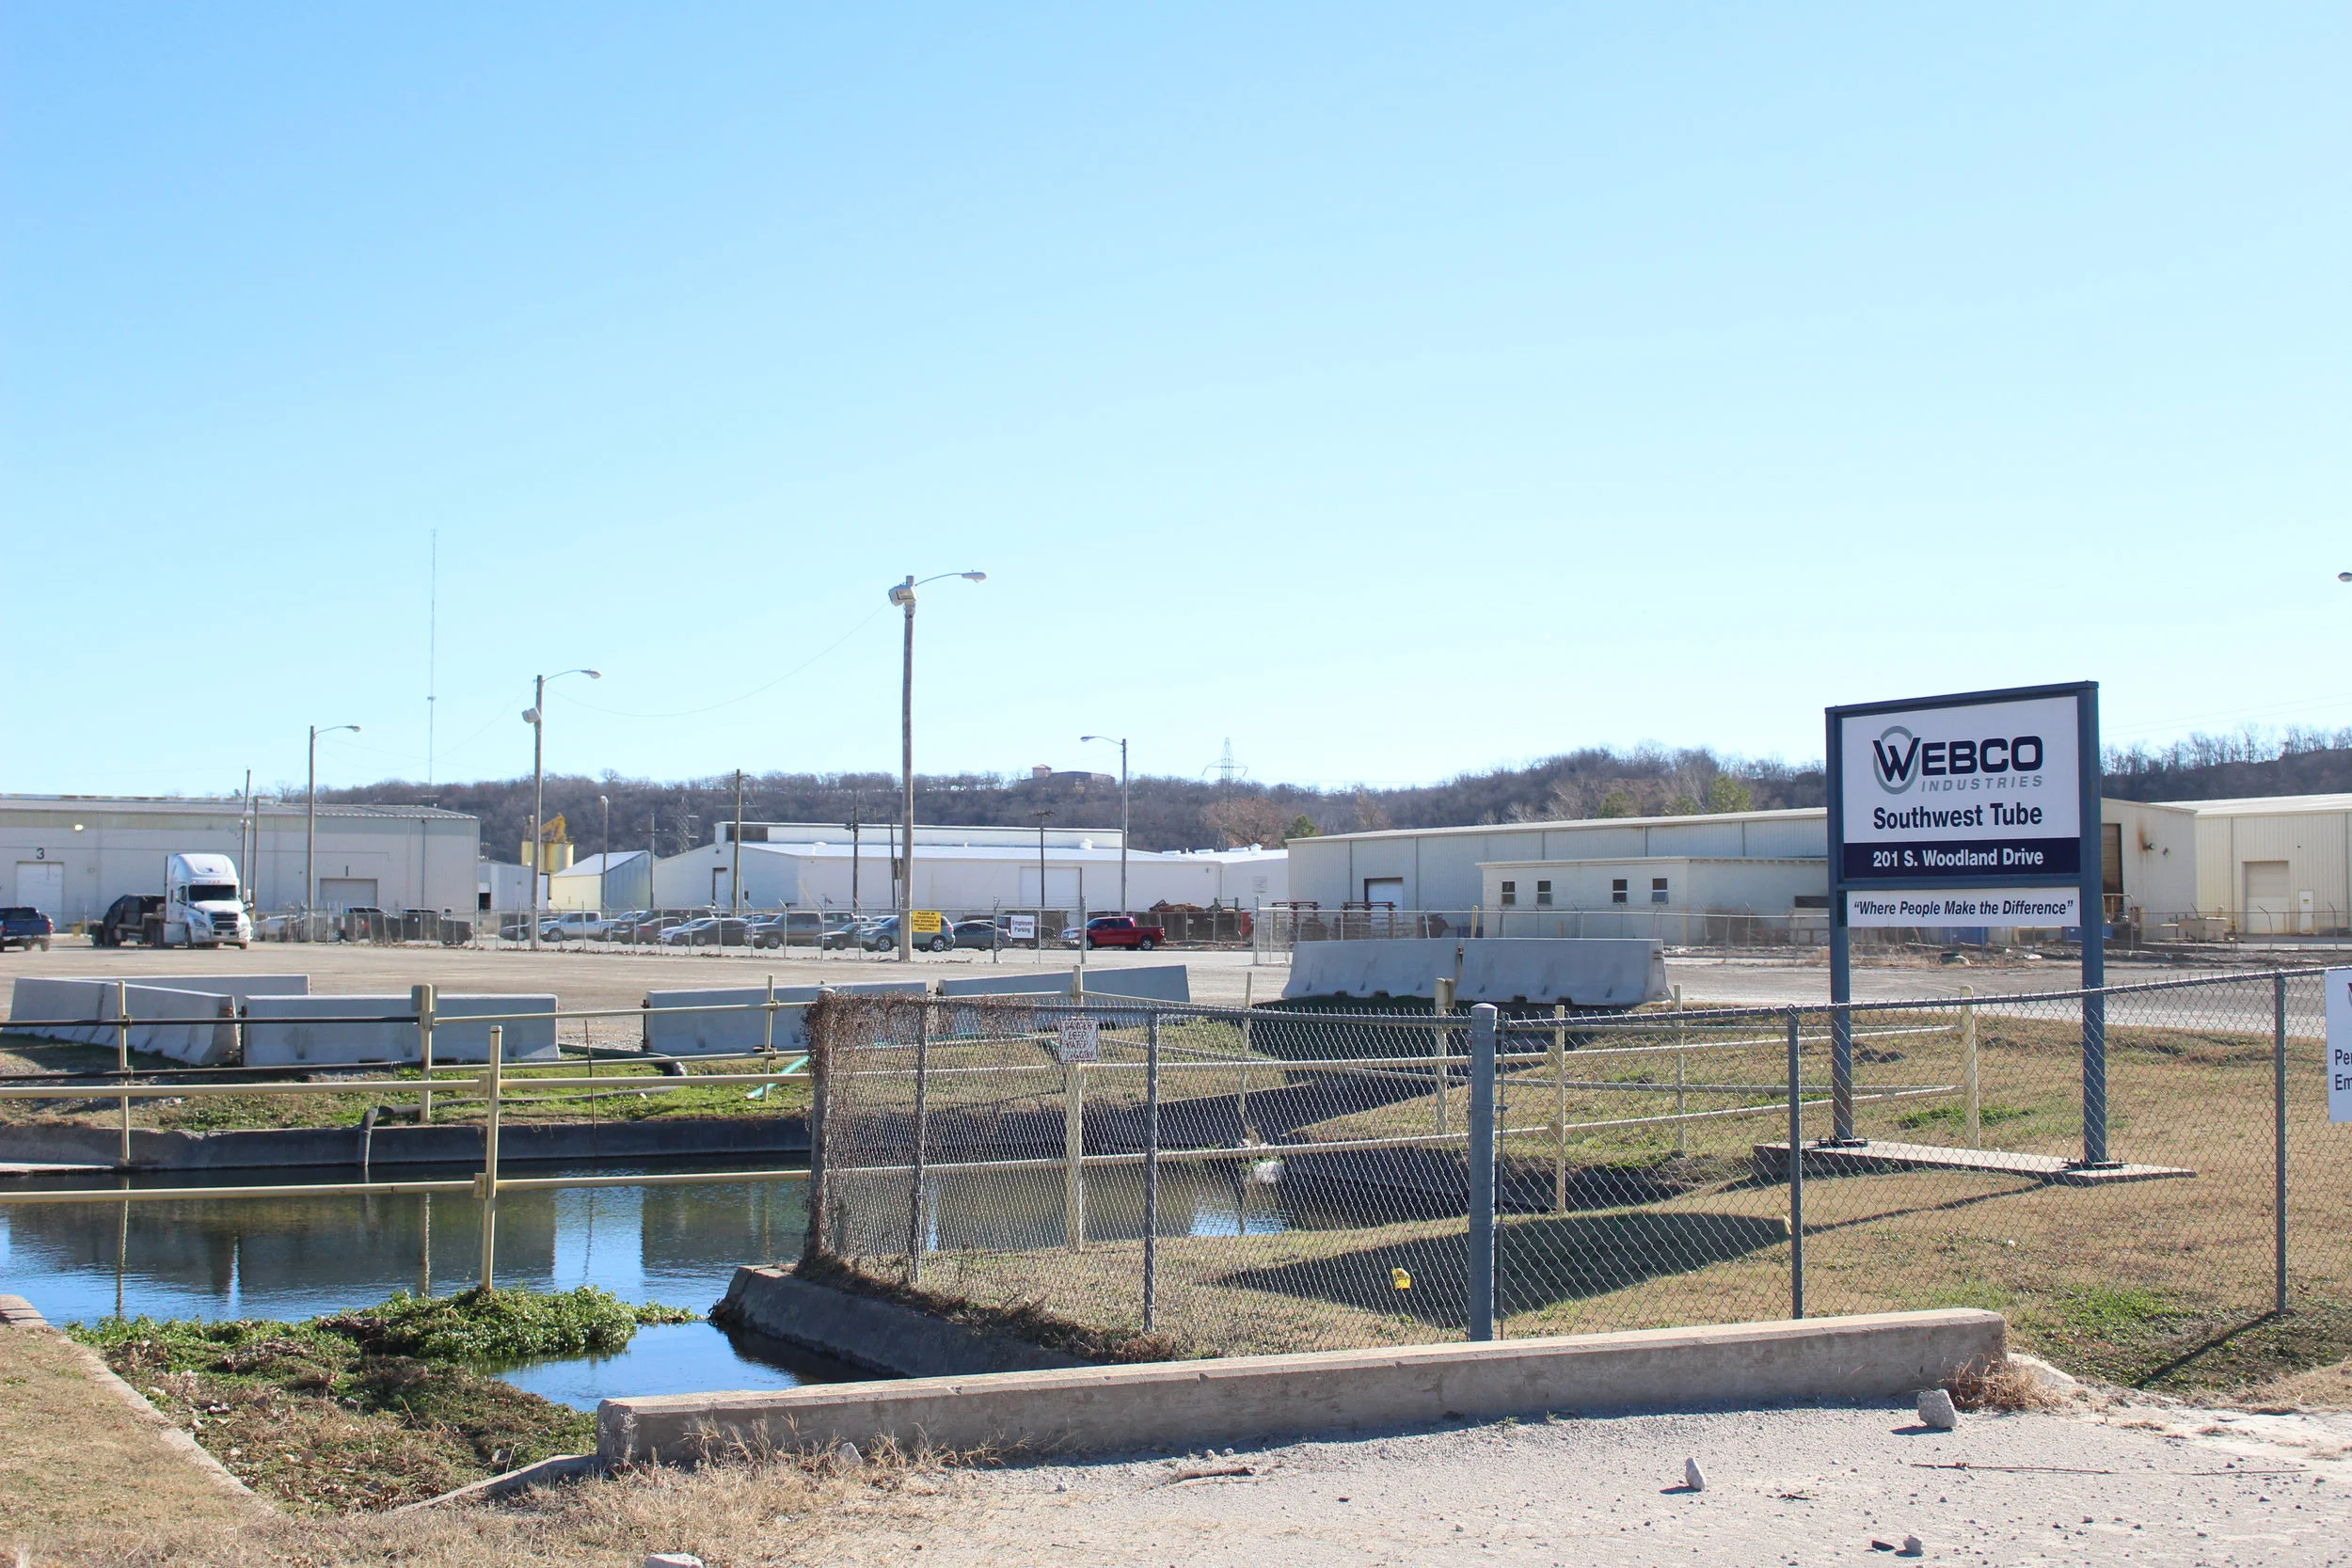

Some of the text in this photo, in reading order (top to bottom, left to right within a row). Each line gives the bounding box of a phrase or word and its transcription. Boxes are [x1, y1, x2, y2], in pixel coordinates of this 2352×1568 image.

[1872, 736, 2043, 782] WEBCO
[1921, 775, 2042, 792] INDUSTRIES
[1873, 802, 2042, 830] Southwest Tube
[37, 847, 44, 860] 3
[1873, 847, 2043, 867] 201 S. Woodland Drive
[1899, 901, 1940, 918] People
[1944, 901, 1976, 915] Make
[1979, 901, 1998, 915] the
